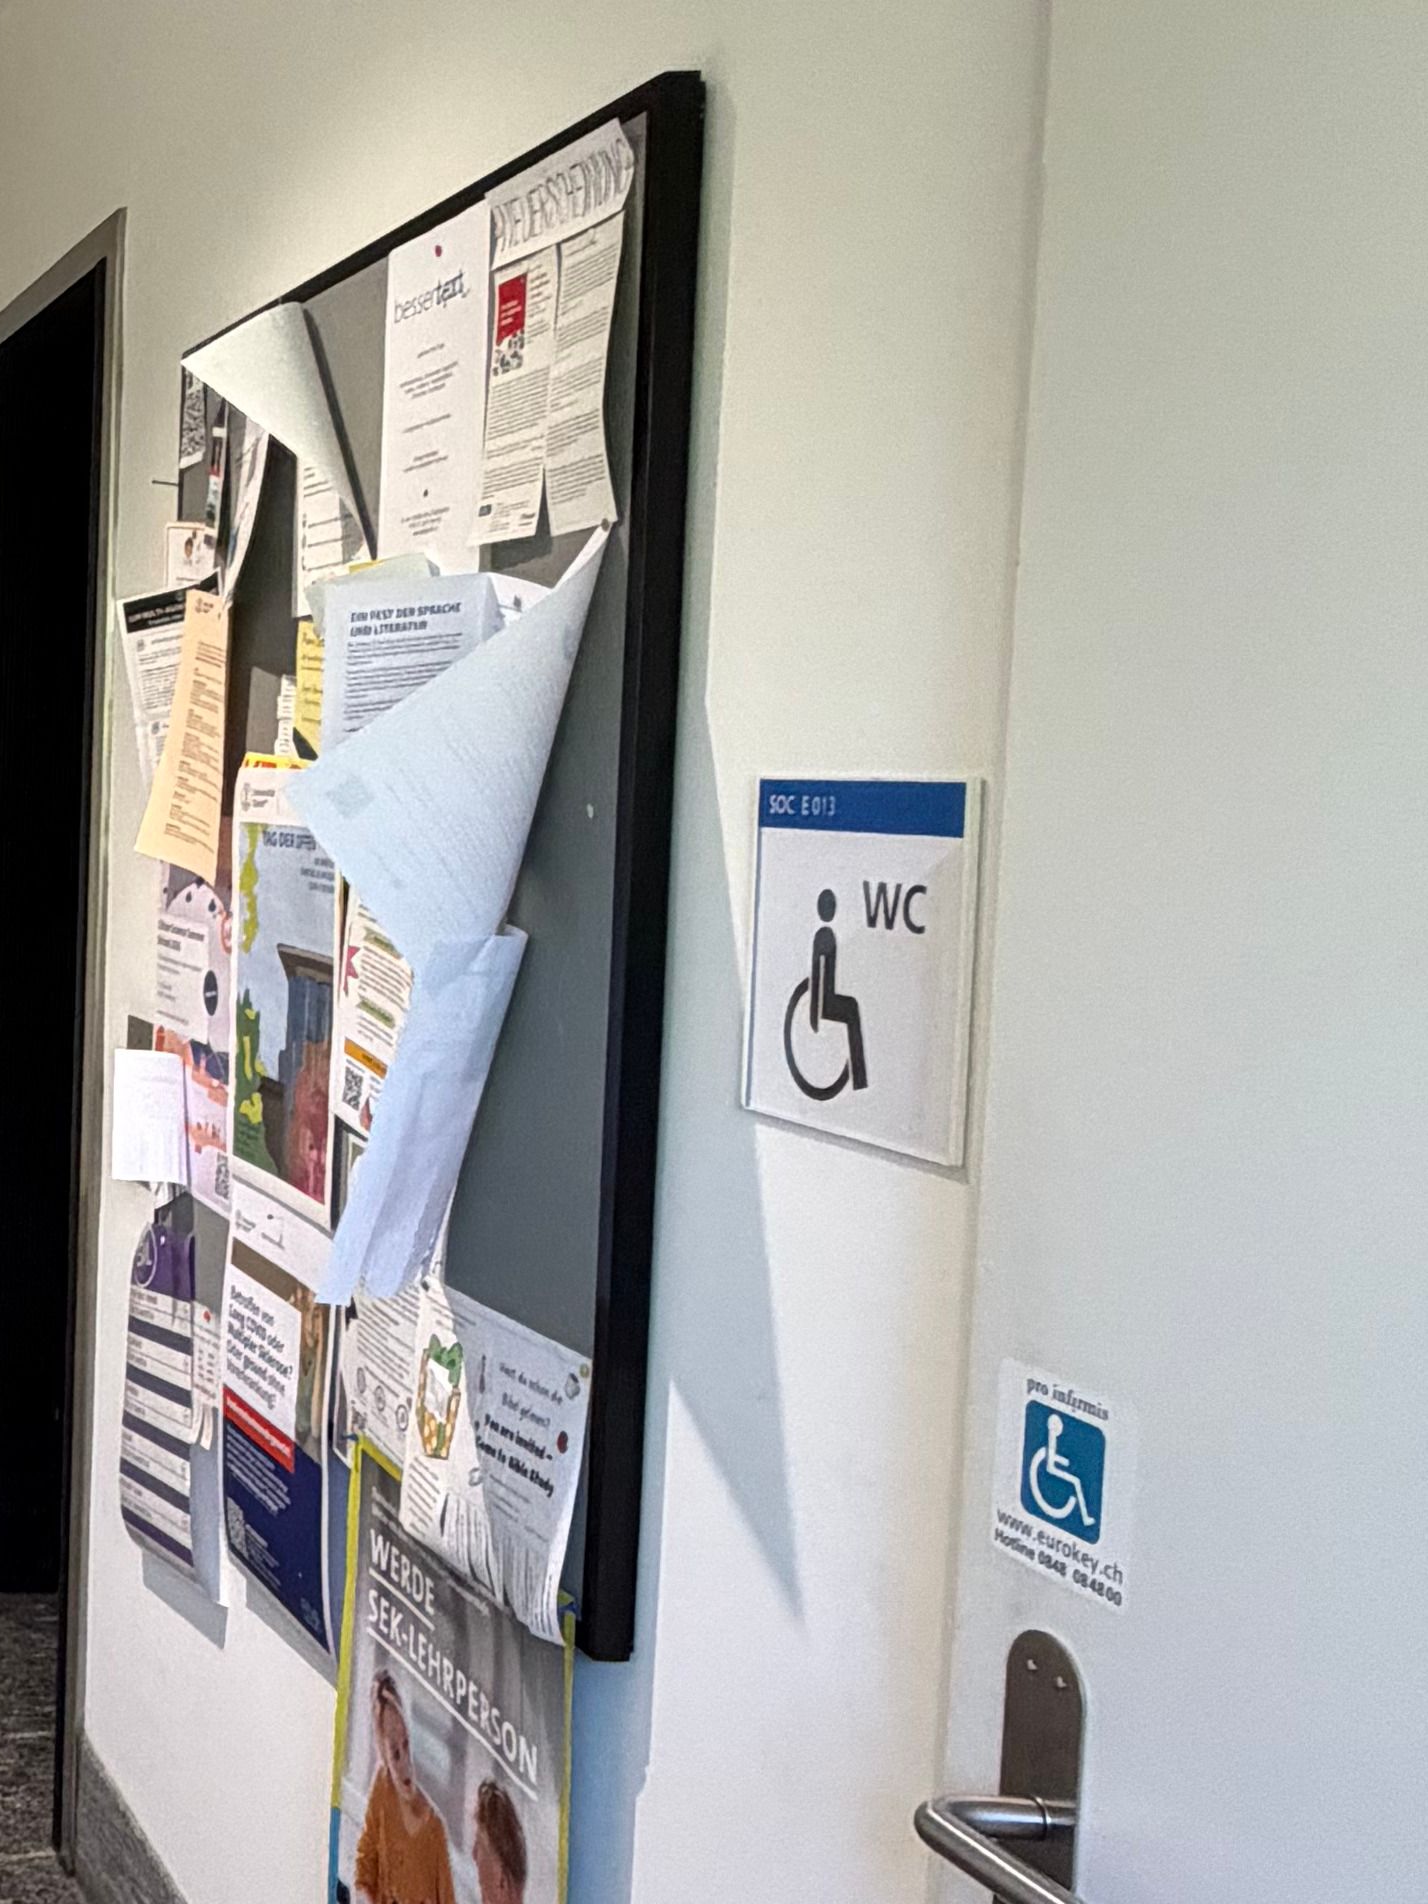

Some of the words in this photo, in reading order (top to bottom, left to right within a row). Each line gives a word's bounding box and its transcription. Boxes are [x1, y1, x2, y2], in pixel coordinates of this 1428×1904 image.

[374, 620, 428, 636] LITERATUR
[417, 601, 462, 617] SPRACHE
[769, 794, 795, 815] SOC
[862, 880, 927, 935] WC
[1026, 1377, 1048, 1396] pro
[1052, 1383, 1109, 1421] infirmis
[484, 1413, 500, 1432] You
[500, 1425, 514, 1442] are
[515, 1430, 546, 1460] invited
[497, 1445, 507, 1464] to
[508, 1455, 529, 1479] Bible
[529, 1467, 555, 1499] Study
[994, 1528, 1036, 1562] Hotline
[997, 1508, 1124, 1586] www.eurokey.ch
[369, 1527, 436, 1616] WERDE
[367, 1587, 538, 1785] SEK-LEHRPERSON
